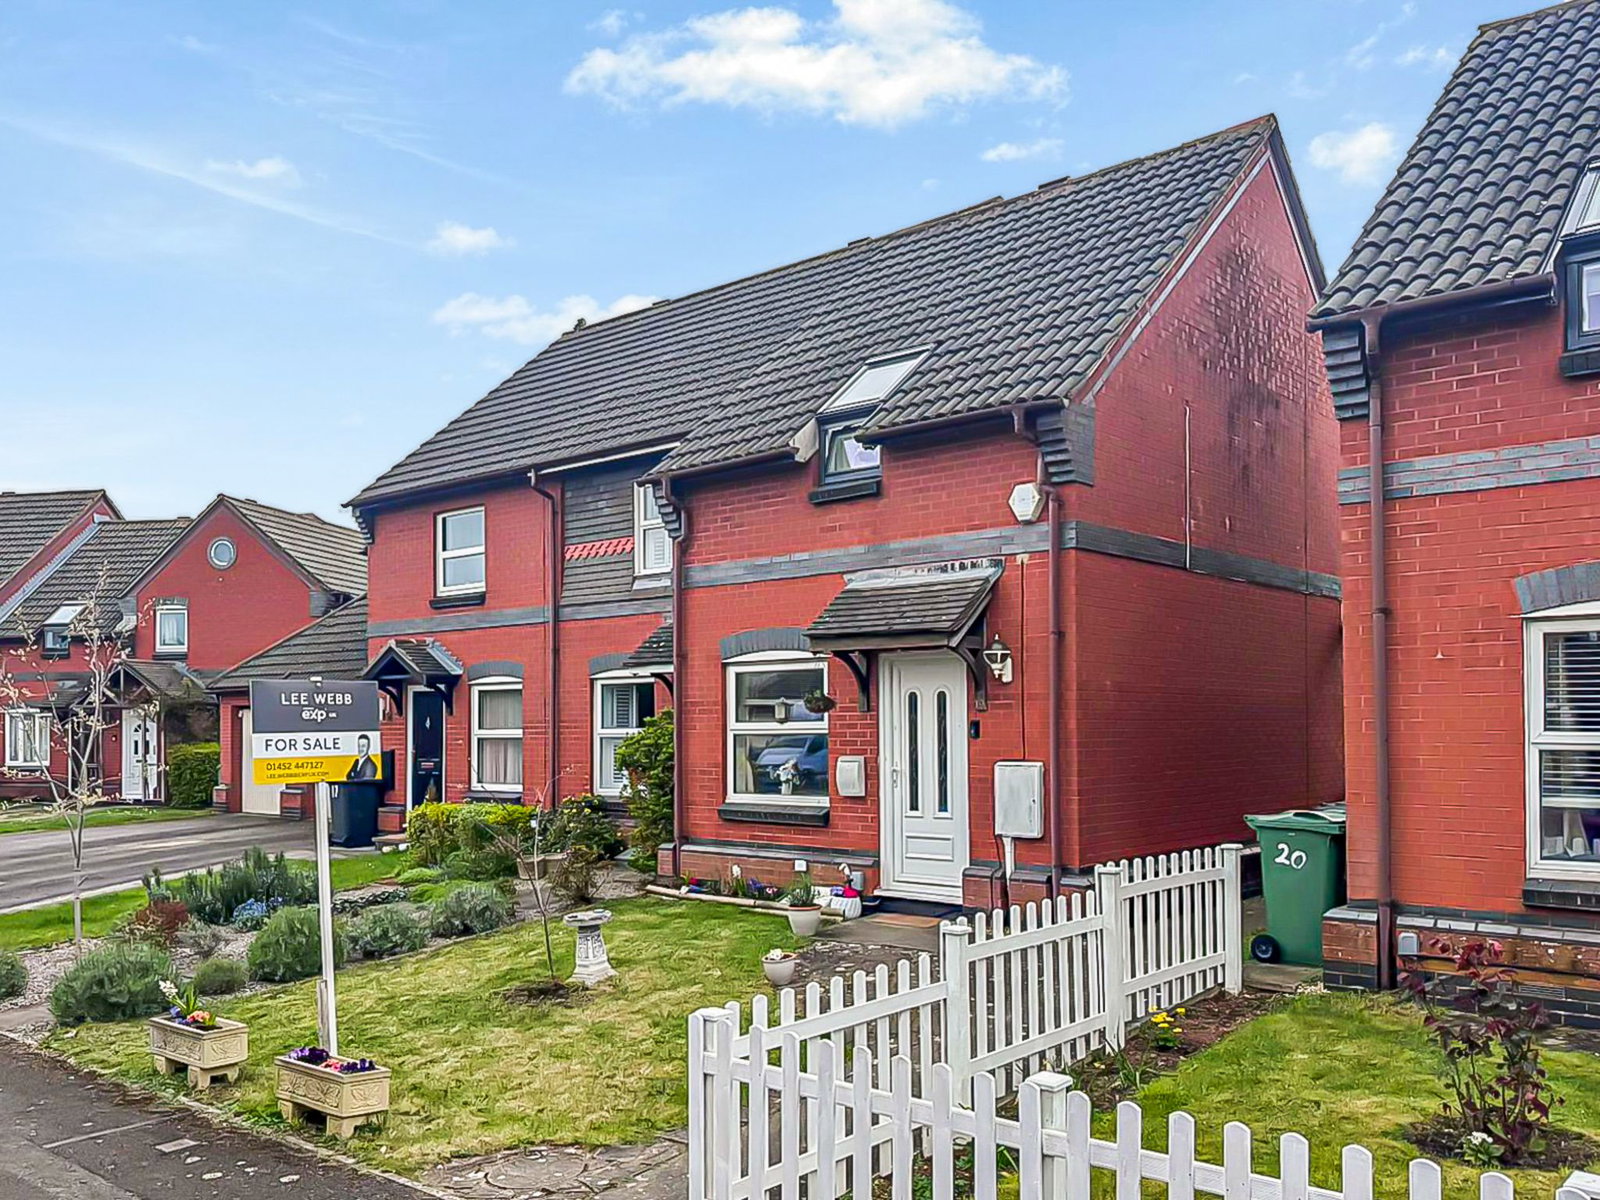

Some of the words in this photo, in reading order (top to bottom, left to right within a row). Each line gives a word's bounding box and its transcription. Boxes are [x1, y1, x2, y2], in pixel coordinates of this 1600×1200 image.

[281, 693, 309, 705] LEE
[314, 693, 353, 705] WEBB
[302, 707, 327, 722] exp
[265, 738, 298, 752] FOR
[303, 737, 341, 751] SALE
[266, 762, 292, 771] 01452
[294, 761, 324, 770] 447127
[1274, 843, 1307, 869] 20
